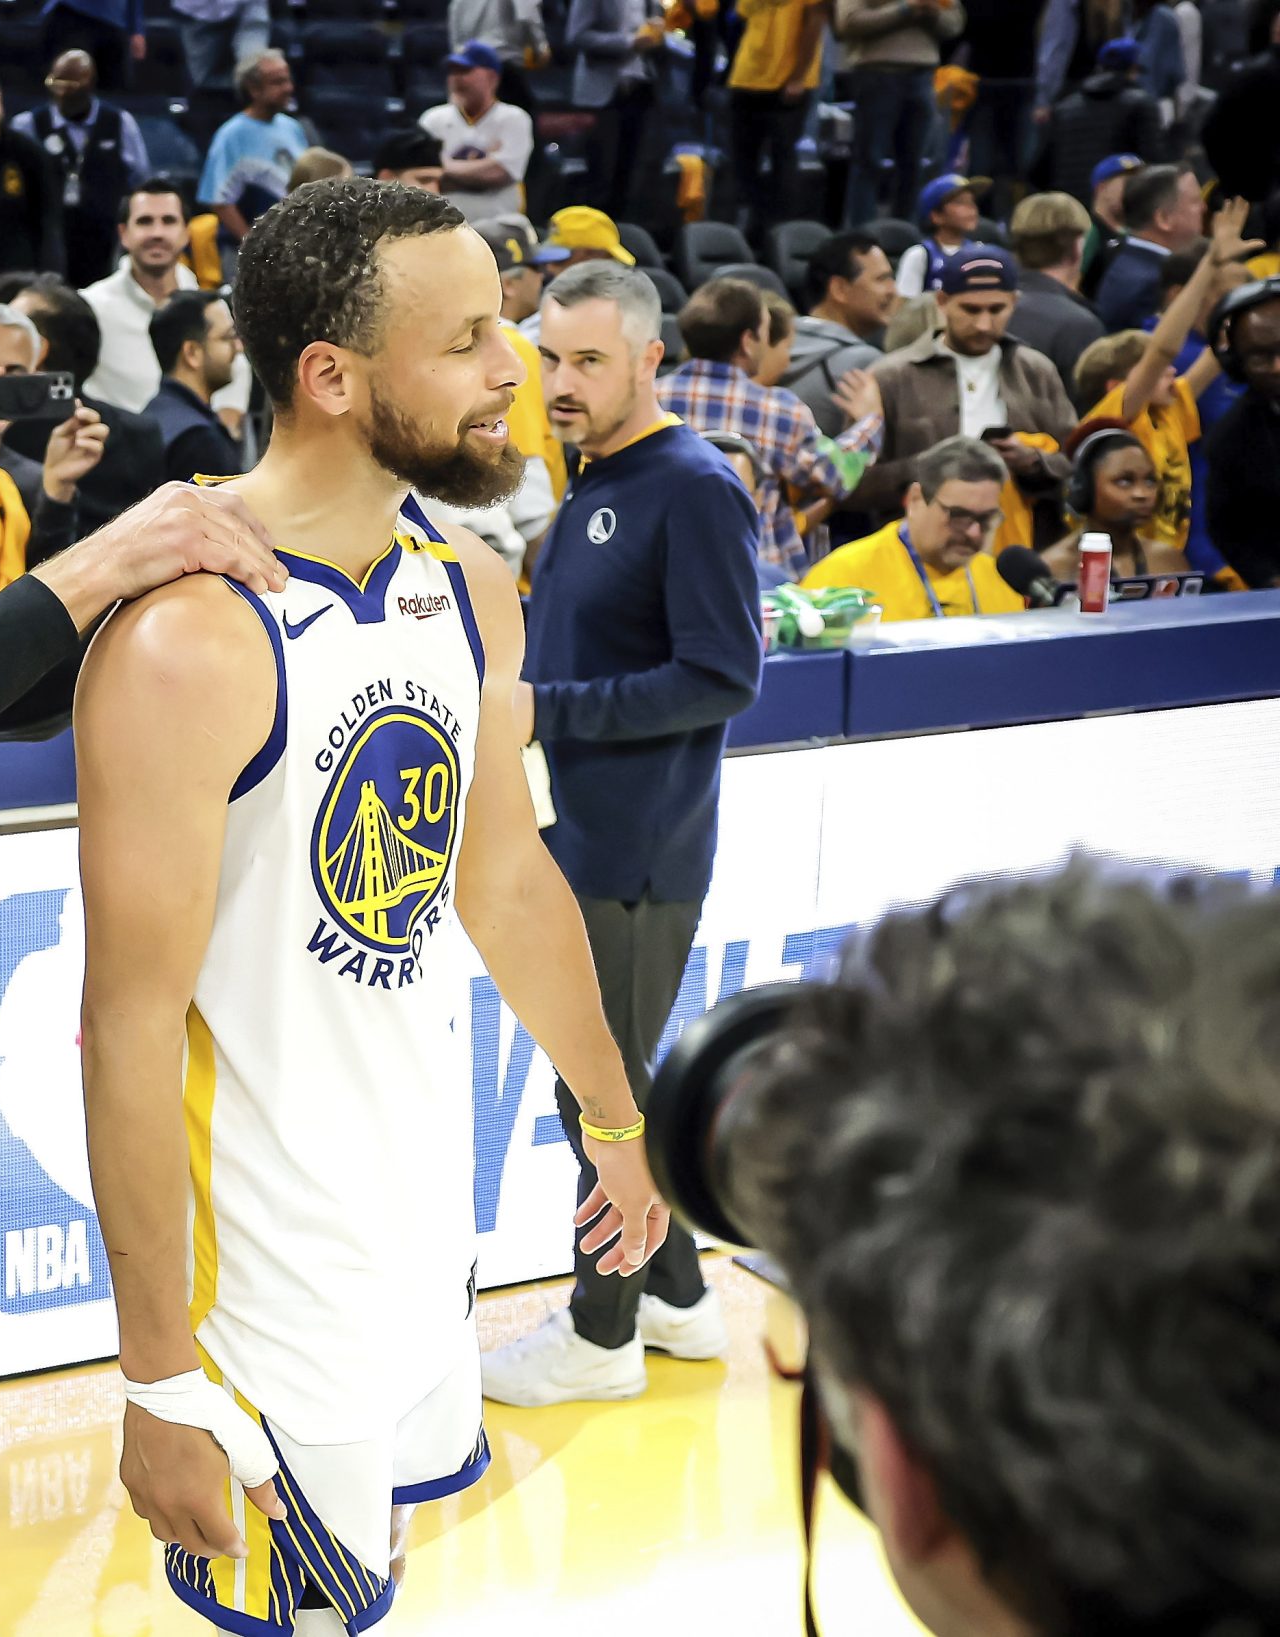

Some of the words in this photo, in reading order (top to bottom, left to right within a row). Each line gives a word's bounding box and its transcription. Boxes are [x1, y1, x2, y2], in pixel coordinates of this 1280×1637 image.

[397, 593, 451, 616] Rakuten
[315, 678, 393, 772] GOLDEN
[405, 680, 462, 743] STATE
[397, 762, 449, 831] 30
[306, 881, 450, 991] WARRORS
[5, 1220, 91, 1300] NBA
